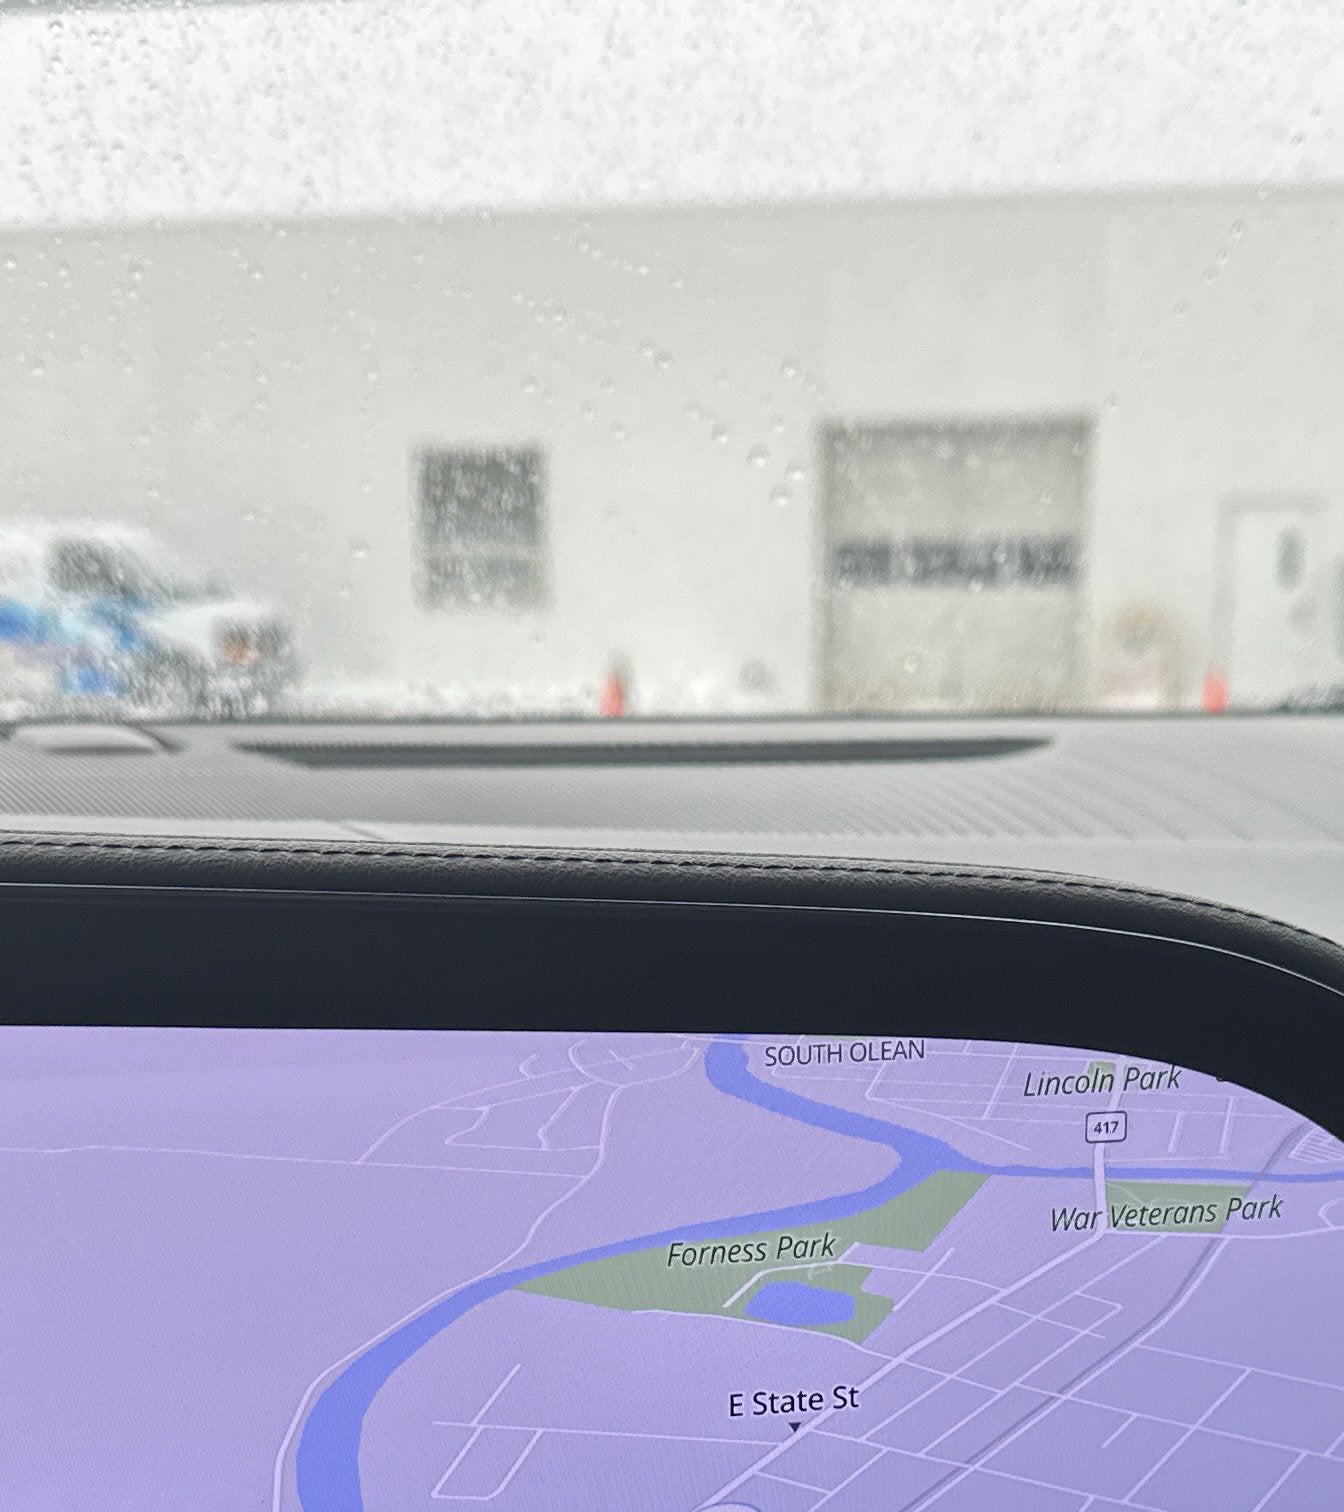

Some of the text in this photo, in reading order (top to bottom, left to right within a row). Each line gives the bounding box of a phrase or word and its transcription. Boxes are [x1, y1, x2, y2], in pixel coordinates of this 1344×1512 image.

[765, 1040, 926, 1067] SOUTH OLEAN
[1024, 1063, 1182, 1097] Lincoln Park
[1093, 1121, 1119, 1135] 417
[1051, 1194, 1284, 1232] War Veterans Park
[667, 1232, 837, 1267] Forness Park
[728, 1384, 859, 1417] E State St
